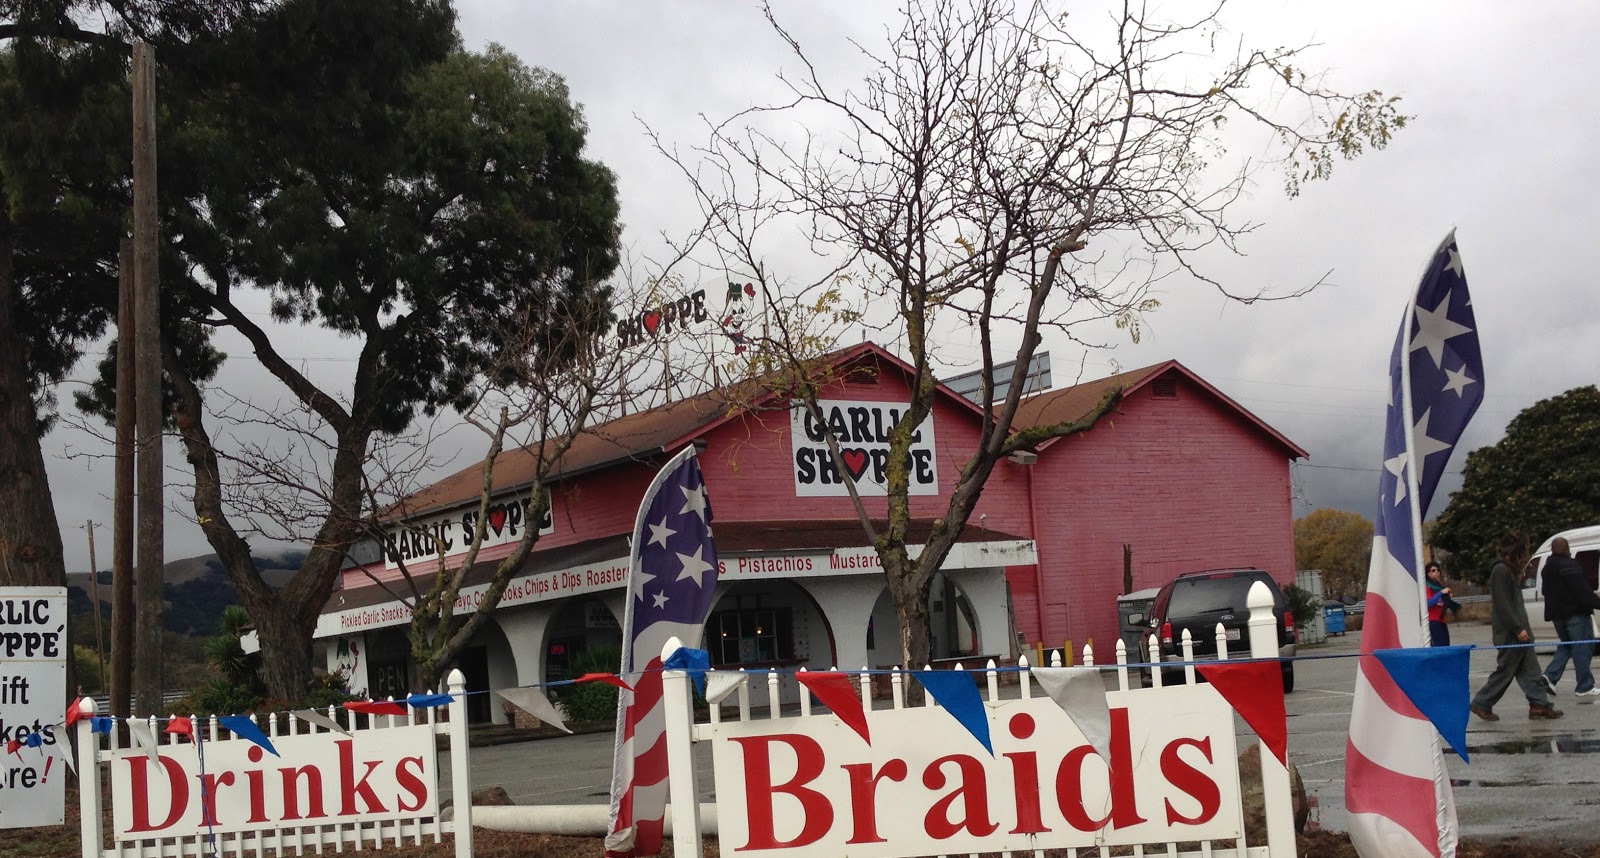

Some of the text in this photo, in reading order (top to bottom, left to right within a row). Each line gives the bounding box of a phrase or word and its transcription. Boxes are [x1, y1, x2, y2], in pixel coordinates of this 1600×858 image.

[804, 405, 922, 443] GARLI
[738, 555, 813, 574] Pistachios
[0, 599, 50, 625] LIC
[341, 612, 362, 629] Pickled
[363, 609, 380, 626] Garlic
[381, 605, 403, 622] Snacks
[525, 578, 549, 598] Chips
[552, 574, 559, 591] &
[561, 571, 582, 592] Dips
[2, 675, 29, 705] ift
[377, 664, 405, 692] PEN
[0, 717, 57, 746] kets
[0, 755, 53, 790] re!
[120, 739, 428, 834] Drinks
[727, 706, 1222, 852] Braids
